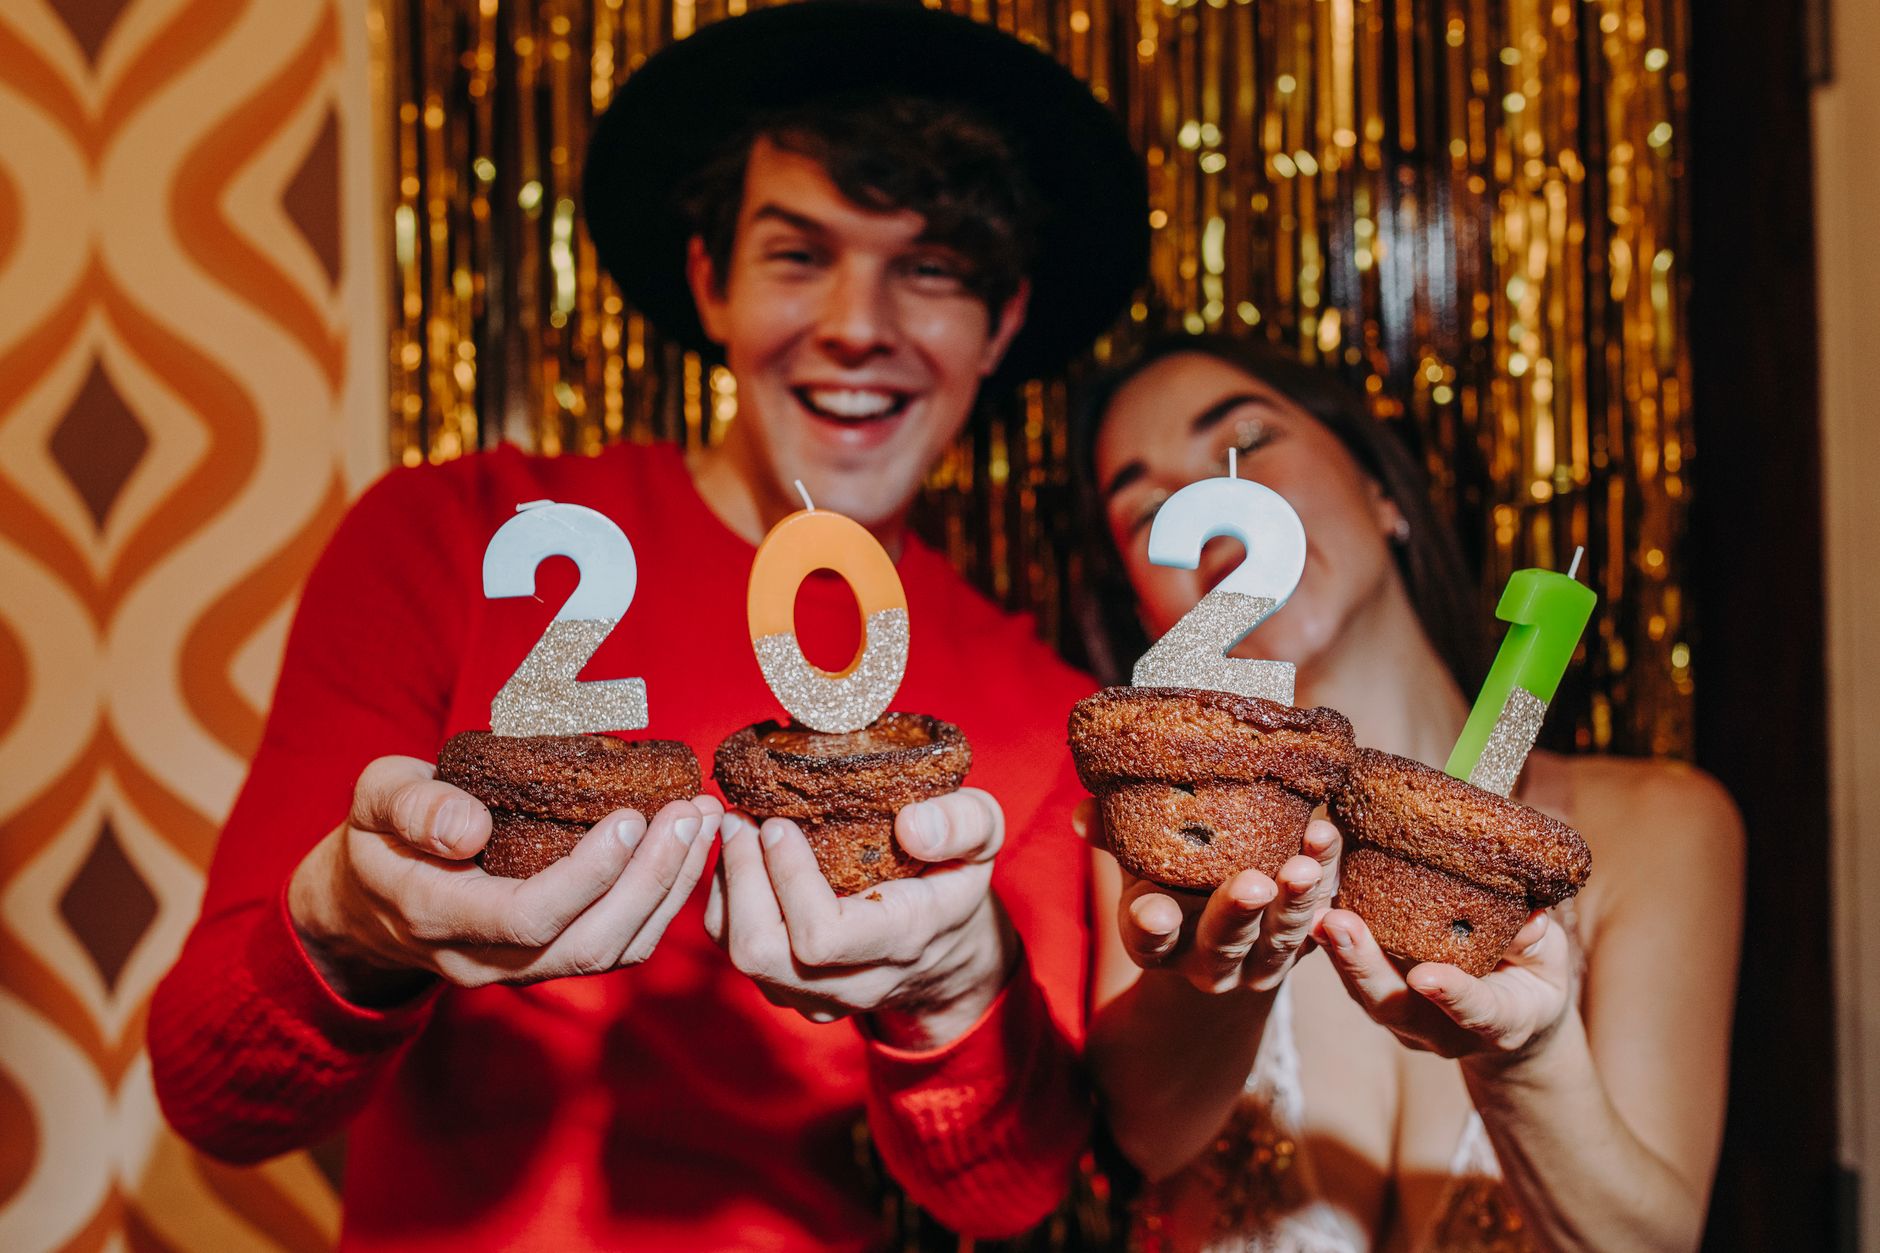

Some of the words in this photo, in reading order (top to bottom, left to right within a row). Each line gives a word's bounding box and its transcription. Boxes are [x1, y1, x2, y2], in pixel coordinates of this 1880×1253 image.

[482, 502, 649, 737] 2
[747, 508, 910, 734] 0
[1131, 477, 1307, 707] 2
[1444, 567, 1598, 799] 1
